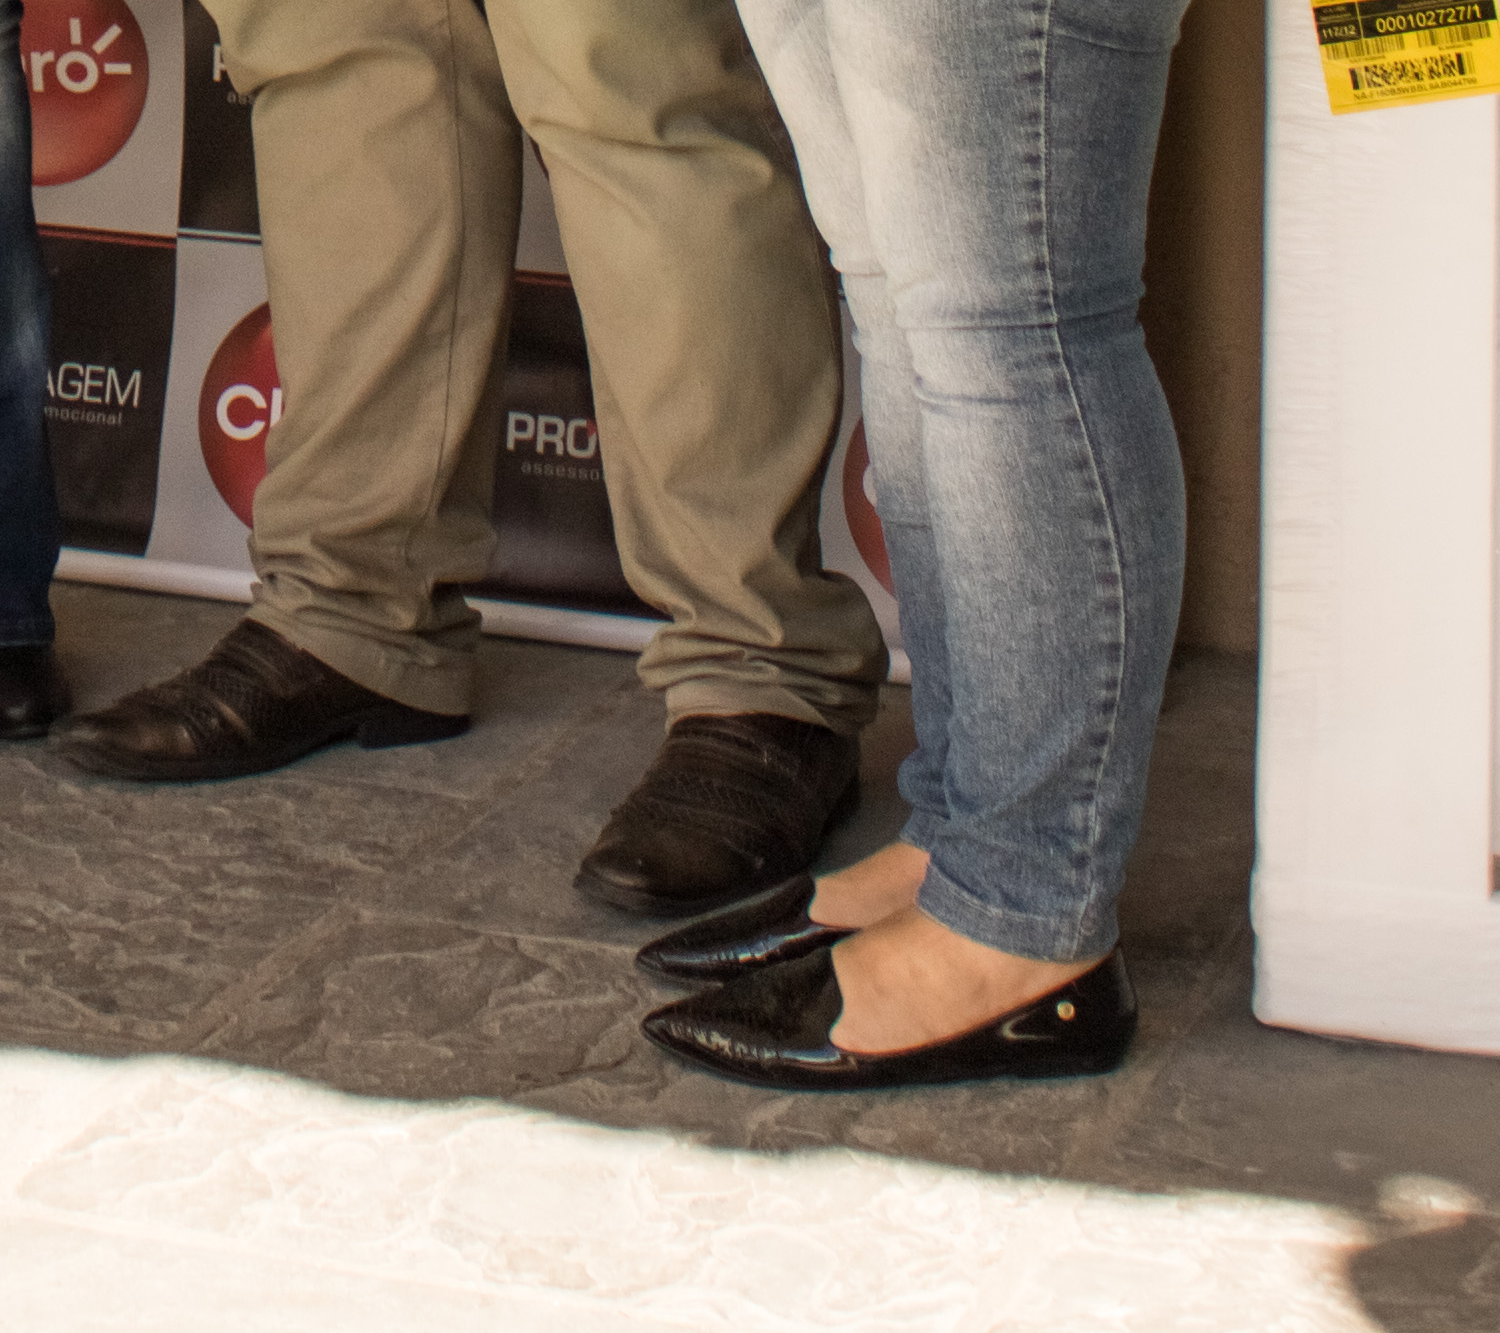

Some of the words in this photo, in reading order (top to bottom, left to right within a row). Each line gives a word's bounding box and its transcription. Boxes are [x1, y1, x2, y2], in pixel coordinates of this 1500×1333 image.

[1375, 3, 1482, 33] 000102727/1
[44, 406, 123, 427] mocional
[520, 461, 600, 481] assesso
